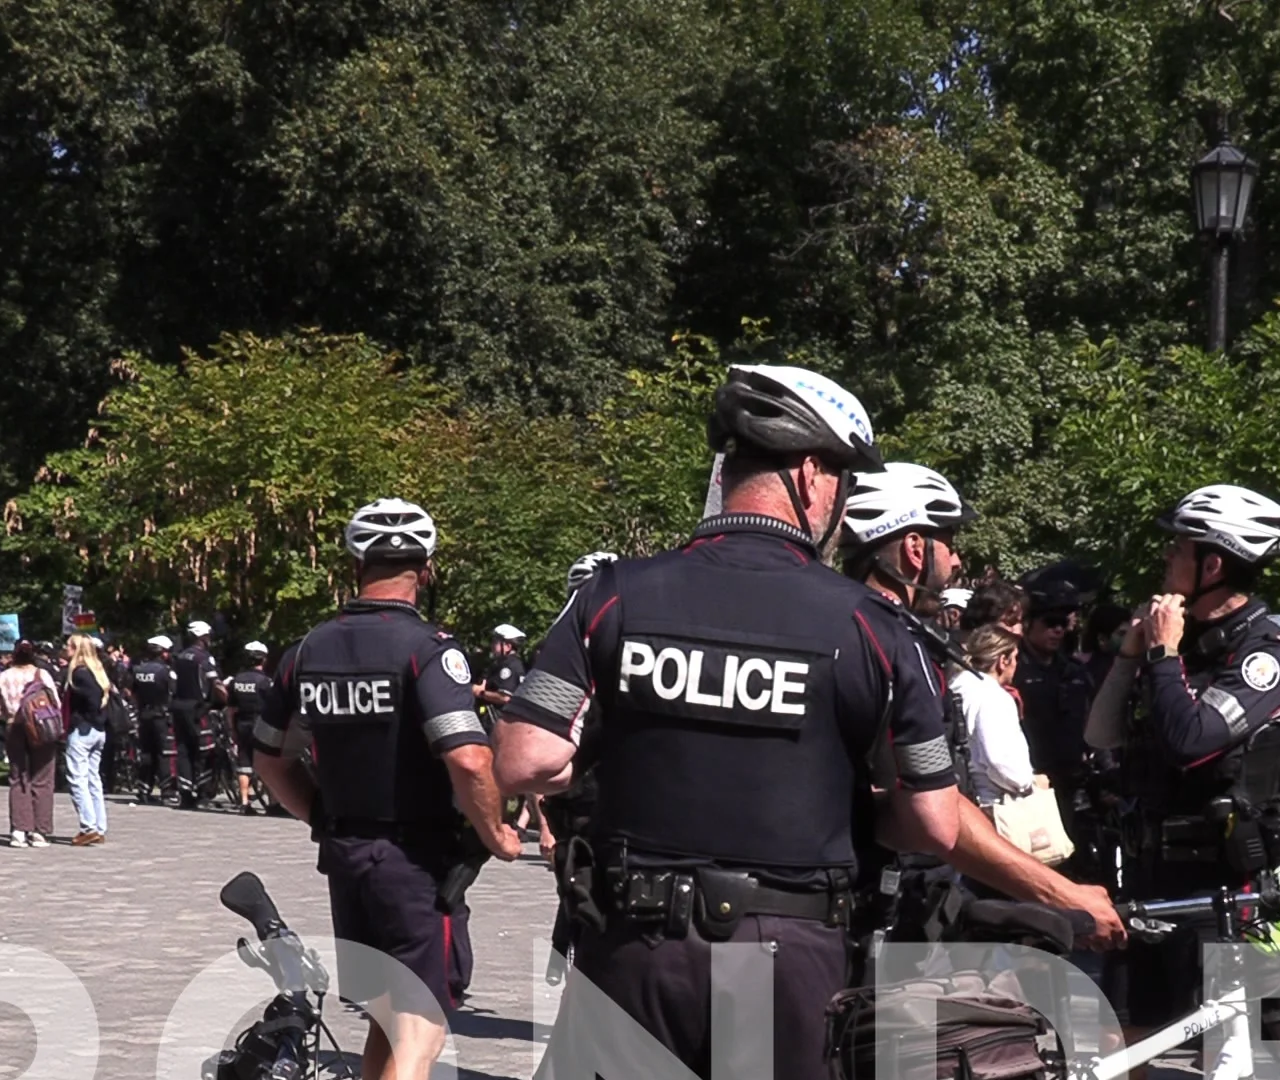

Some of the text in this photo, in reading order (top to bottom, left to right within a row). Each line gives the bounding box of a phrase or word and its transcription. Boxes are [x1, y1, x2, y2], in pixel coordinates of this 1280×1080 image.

[865, 510, 918, 538] POLICE
[1216, 535, 1256, 560] POLICE
[234, 682, 256, 693] POLICE
[620, 641, 809, 715] POLICE
[300, 680, 394, 715] POLICE
[1184, 1010, 1221, 1040] POLICE
